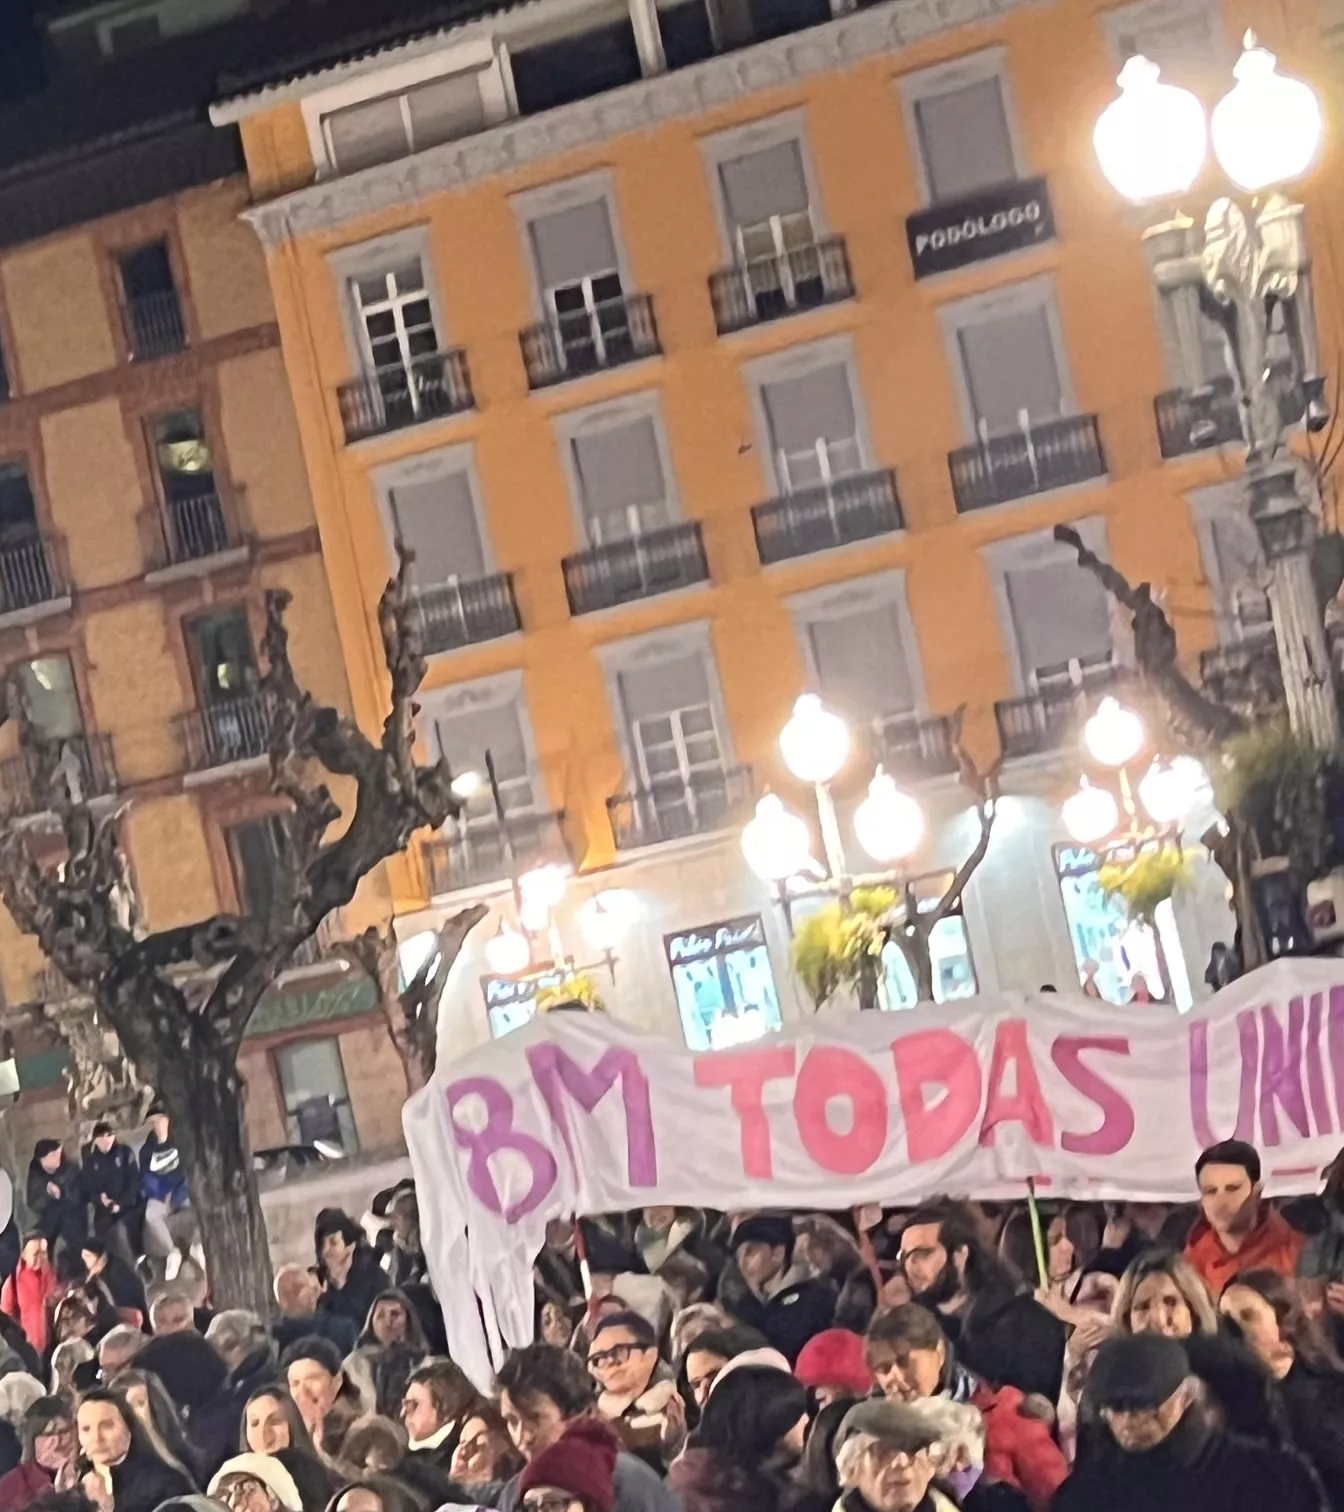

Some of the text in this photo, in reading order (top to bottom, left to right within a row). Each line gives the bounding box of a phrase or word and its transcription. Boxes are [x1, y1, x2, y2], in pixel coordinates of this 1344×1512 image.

[447, 984, 1344, 1223] 8M TODAS UNI
